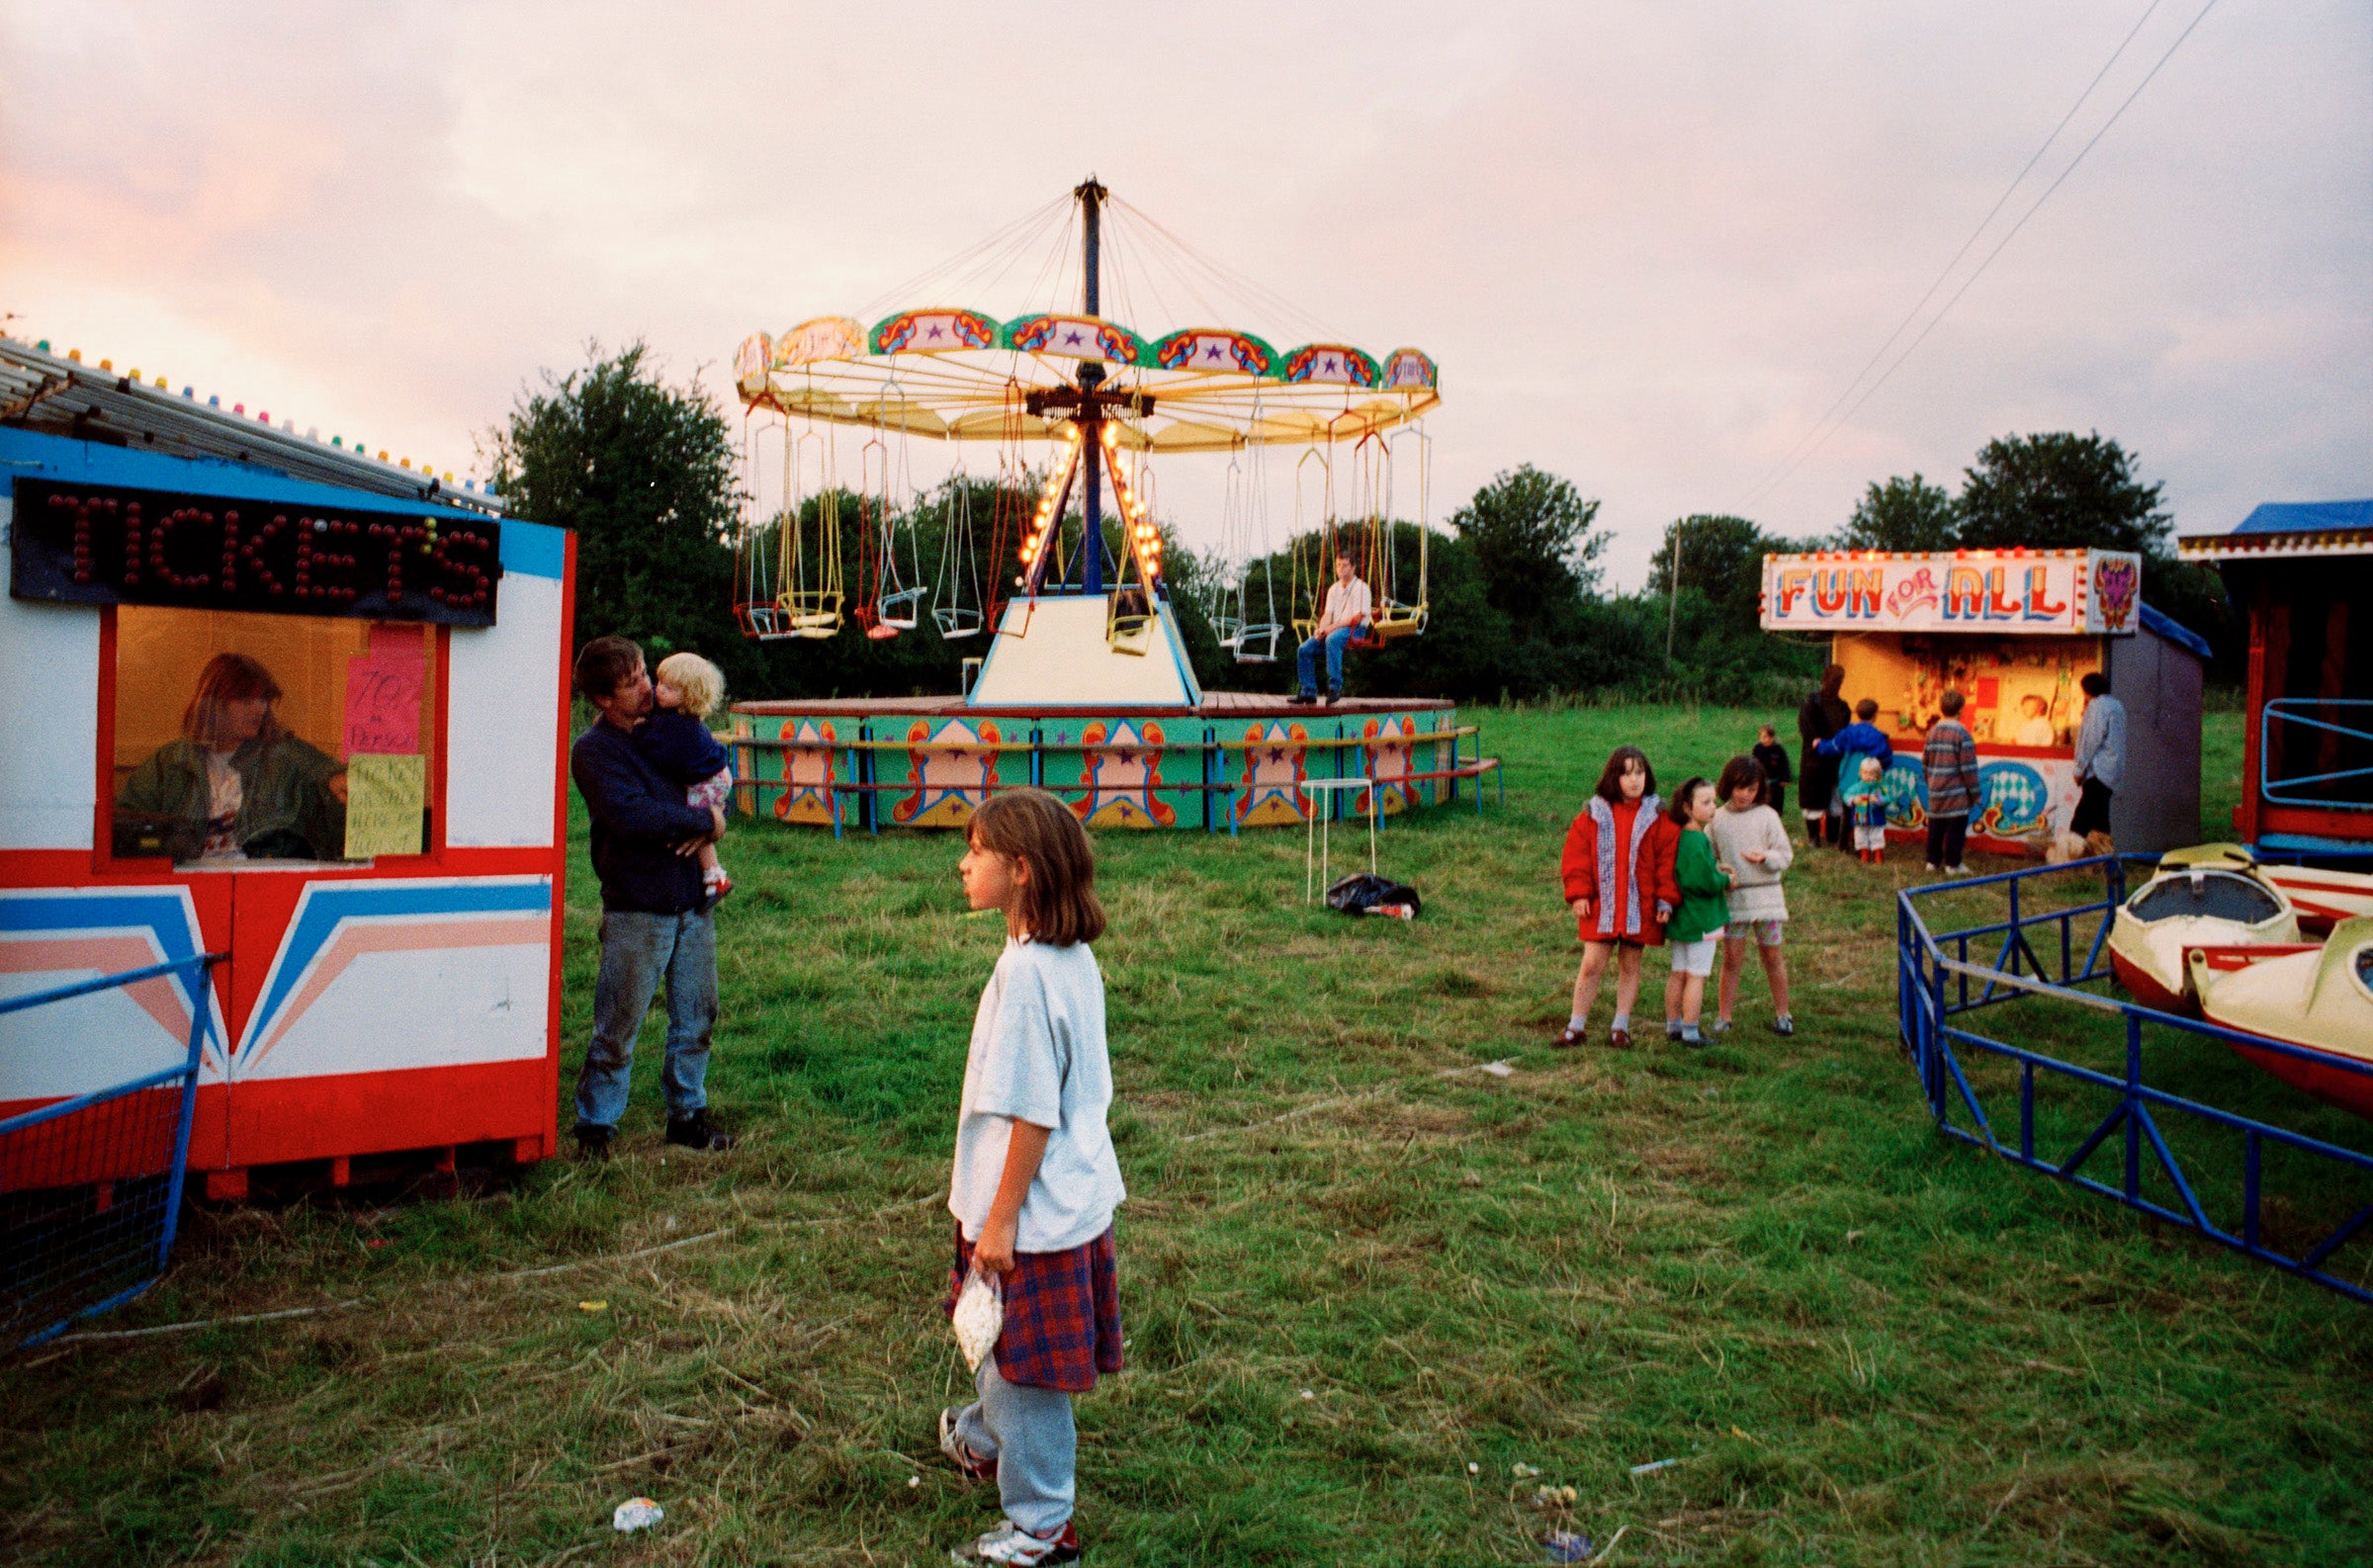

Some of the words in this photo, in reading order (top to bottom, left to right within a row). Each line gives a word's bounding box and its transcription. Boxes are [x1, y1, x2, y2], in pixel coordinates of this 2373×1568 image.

[48, 494, 489, 607] TICKETS
[1776, 567, 1883, 618] FUN
[1886, 567, 1936, 617] FOR
[1942, 566, 2066, 621] ALL
